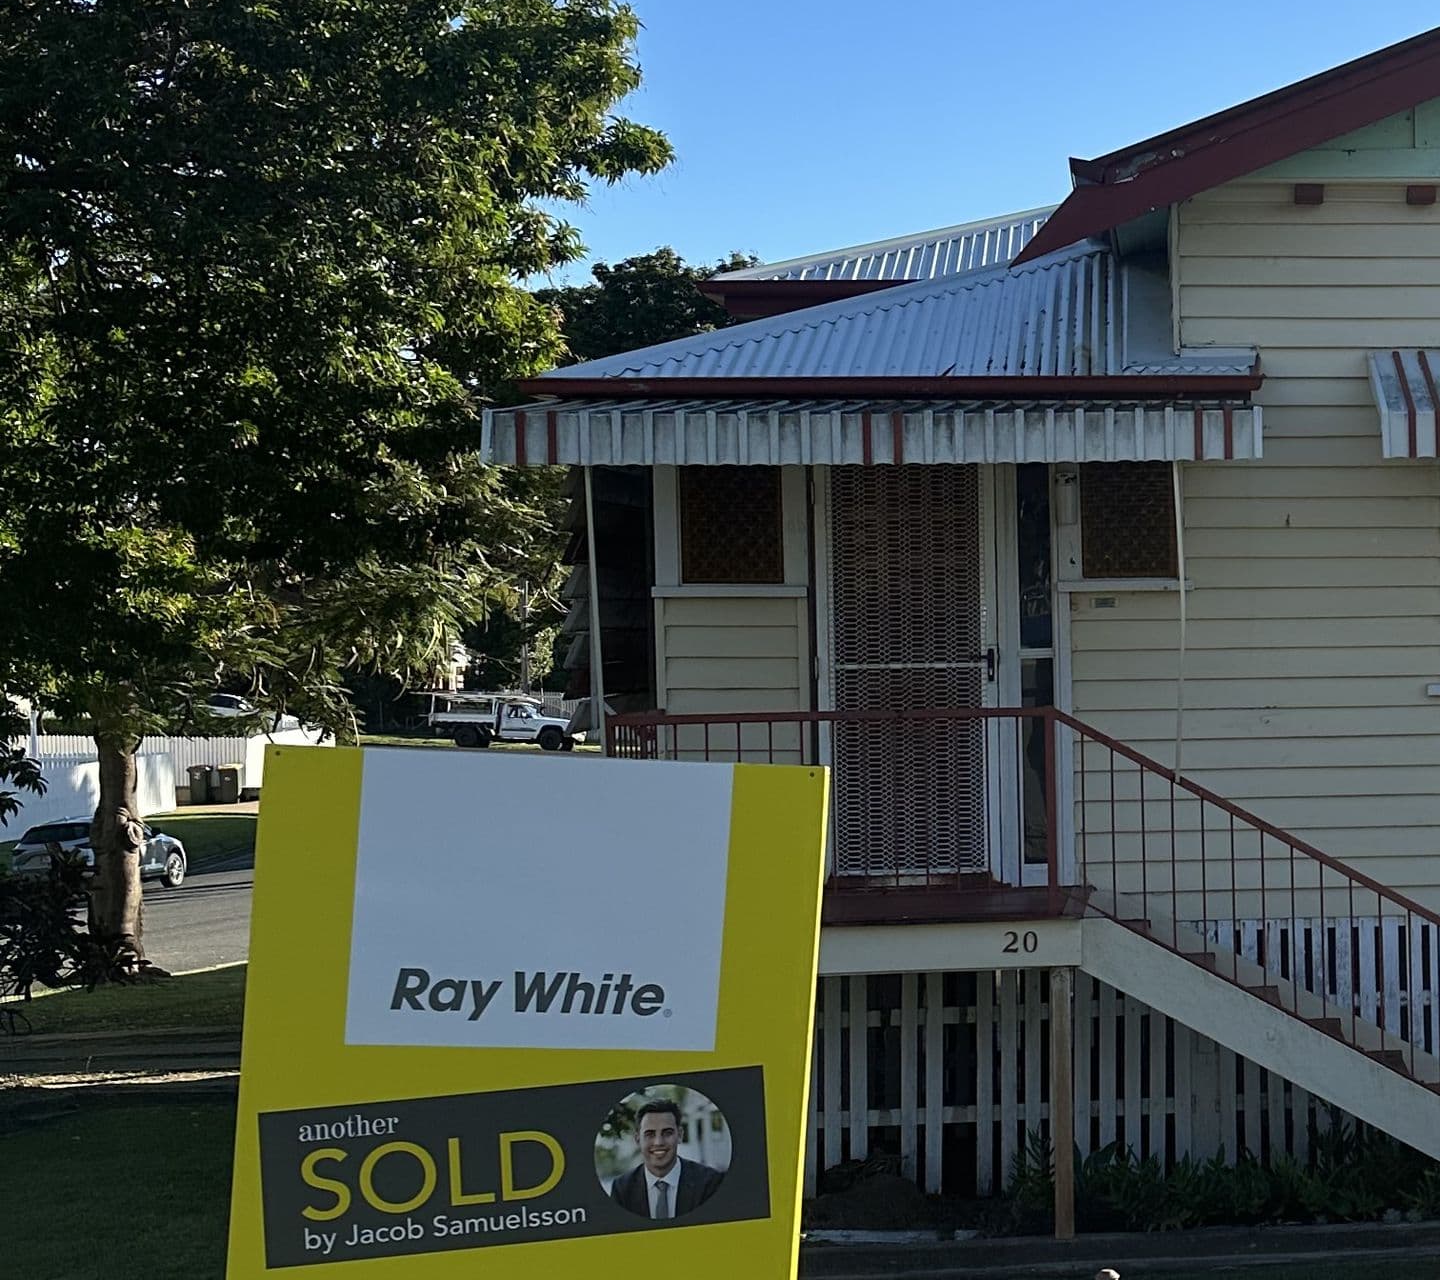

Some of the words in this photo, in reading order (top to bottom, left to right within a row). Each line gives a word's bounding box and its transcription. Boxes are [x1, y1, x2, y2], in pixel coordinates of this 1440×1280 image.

[1003, 931, 1038, 953] 20
[390, 968, 502, 1021] Ray
[515, 971, 665, 1017] White
[298, 1113, 399, 1142] another
[300, 1130, 566, 1221] SOLD
[303, 1229, 336, 1254] by
[345, 1220, 424, 1247] Jacob
[432, 1205, 587, 1237] Samuelsson
